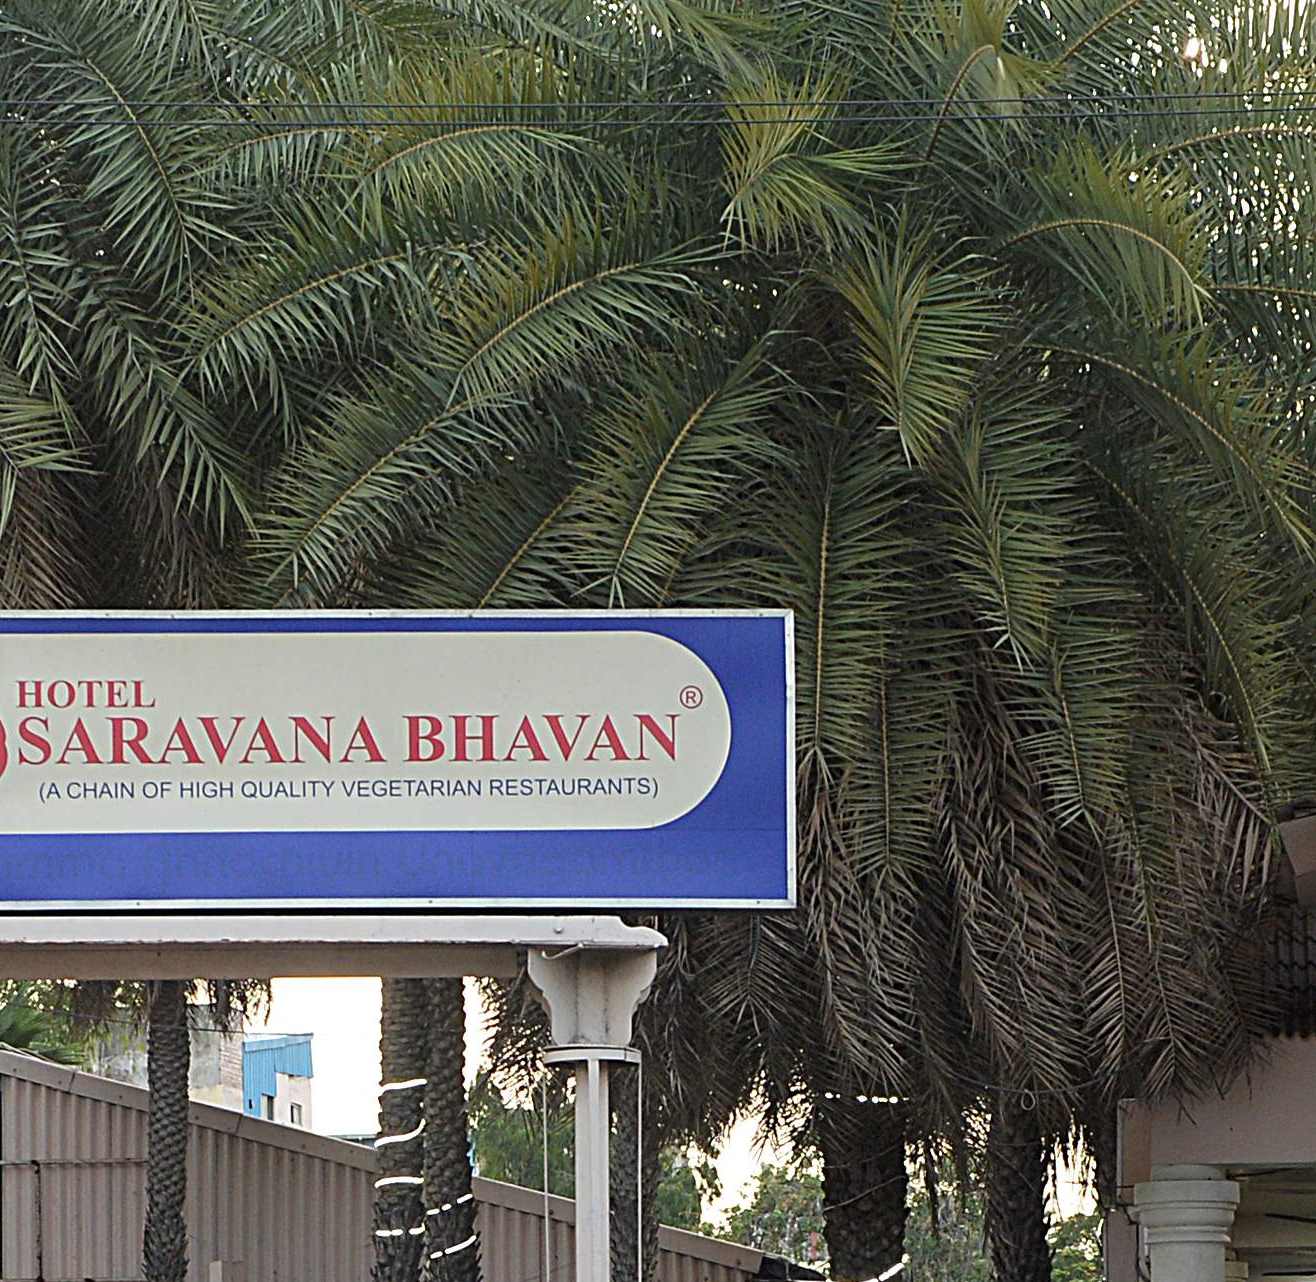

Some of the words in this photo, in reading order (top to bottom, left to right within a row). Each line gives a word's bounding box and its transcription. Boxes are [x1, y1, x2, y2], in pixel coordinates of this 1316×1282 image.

[16, 680, 156, 709] HOTEL
[17, 716, 386, 765] SARAVANA
[403, 713, 680, 762] BHAVAN
[39, 781, 62, 803] (A
[66, 781, 135, 799] CHAIN
[142, 781, 173, 799] OF
[179, 780, 234, 799] HIGH
[240, 780, 336, 799] QUALITY
[341, 779, 482, 798] VEGETARIAN
[489, 777, 660, 799] RESTAURANTS)
